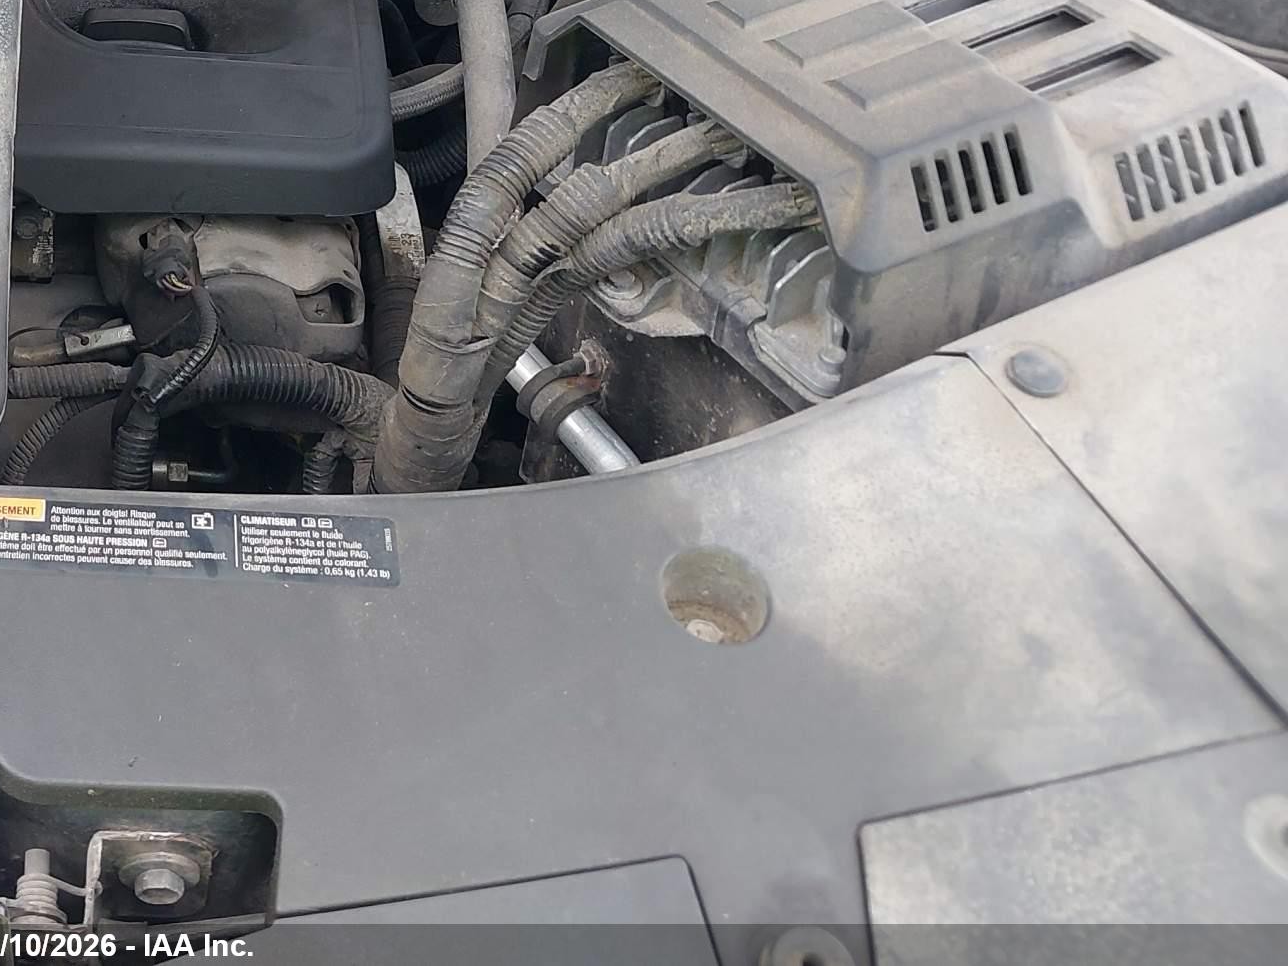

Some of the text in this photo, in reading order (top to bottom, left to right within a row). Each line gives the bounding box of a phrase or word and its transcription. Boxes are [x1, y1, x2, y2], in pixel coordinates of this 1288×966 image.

[50, 506, 85, 515] Attention
[156, 520, 174, 529] peut
[240, 516, 296, 527] CLIMATISEUR
[241, 527, 268, 536] Utiliser
[20, 533, 51, 542] R-134a
[52, 535, 75, 544] SOUS
[76, 536, 105, 545] HAUTE
[105, 537, 148, 547] PRESSION
[285, 538, 315, 548] R-134a
